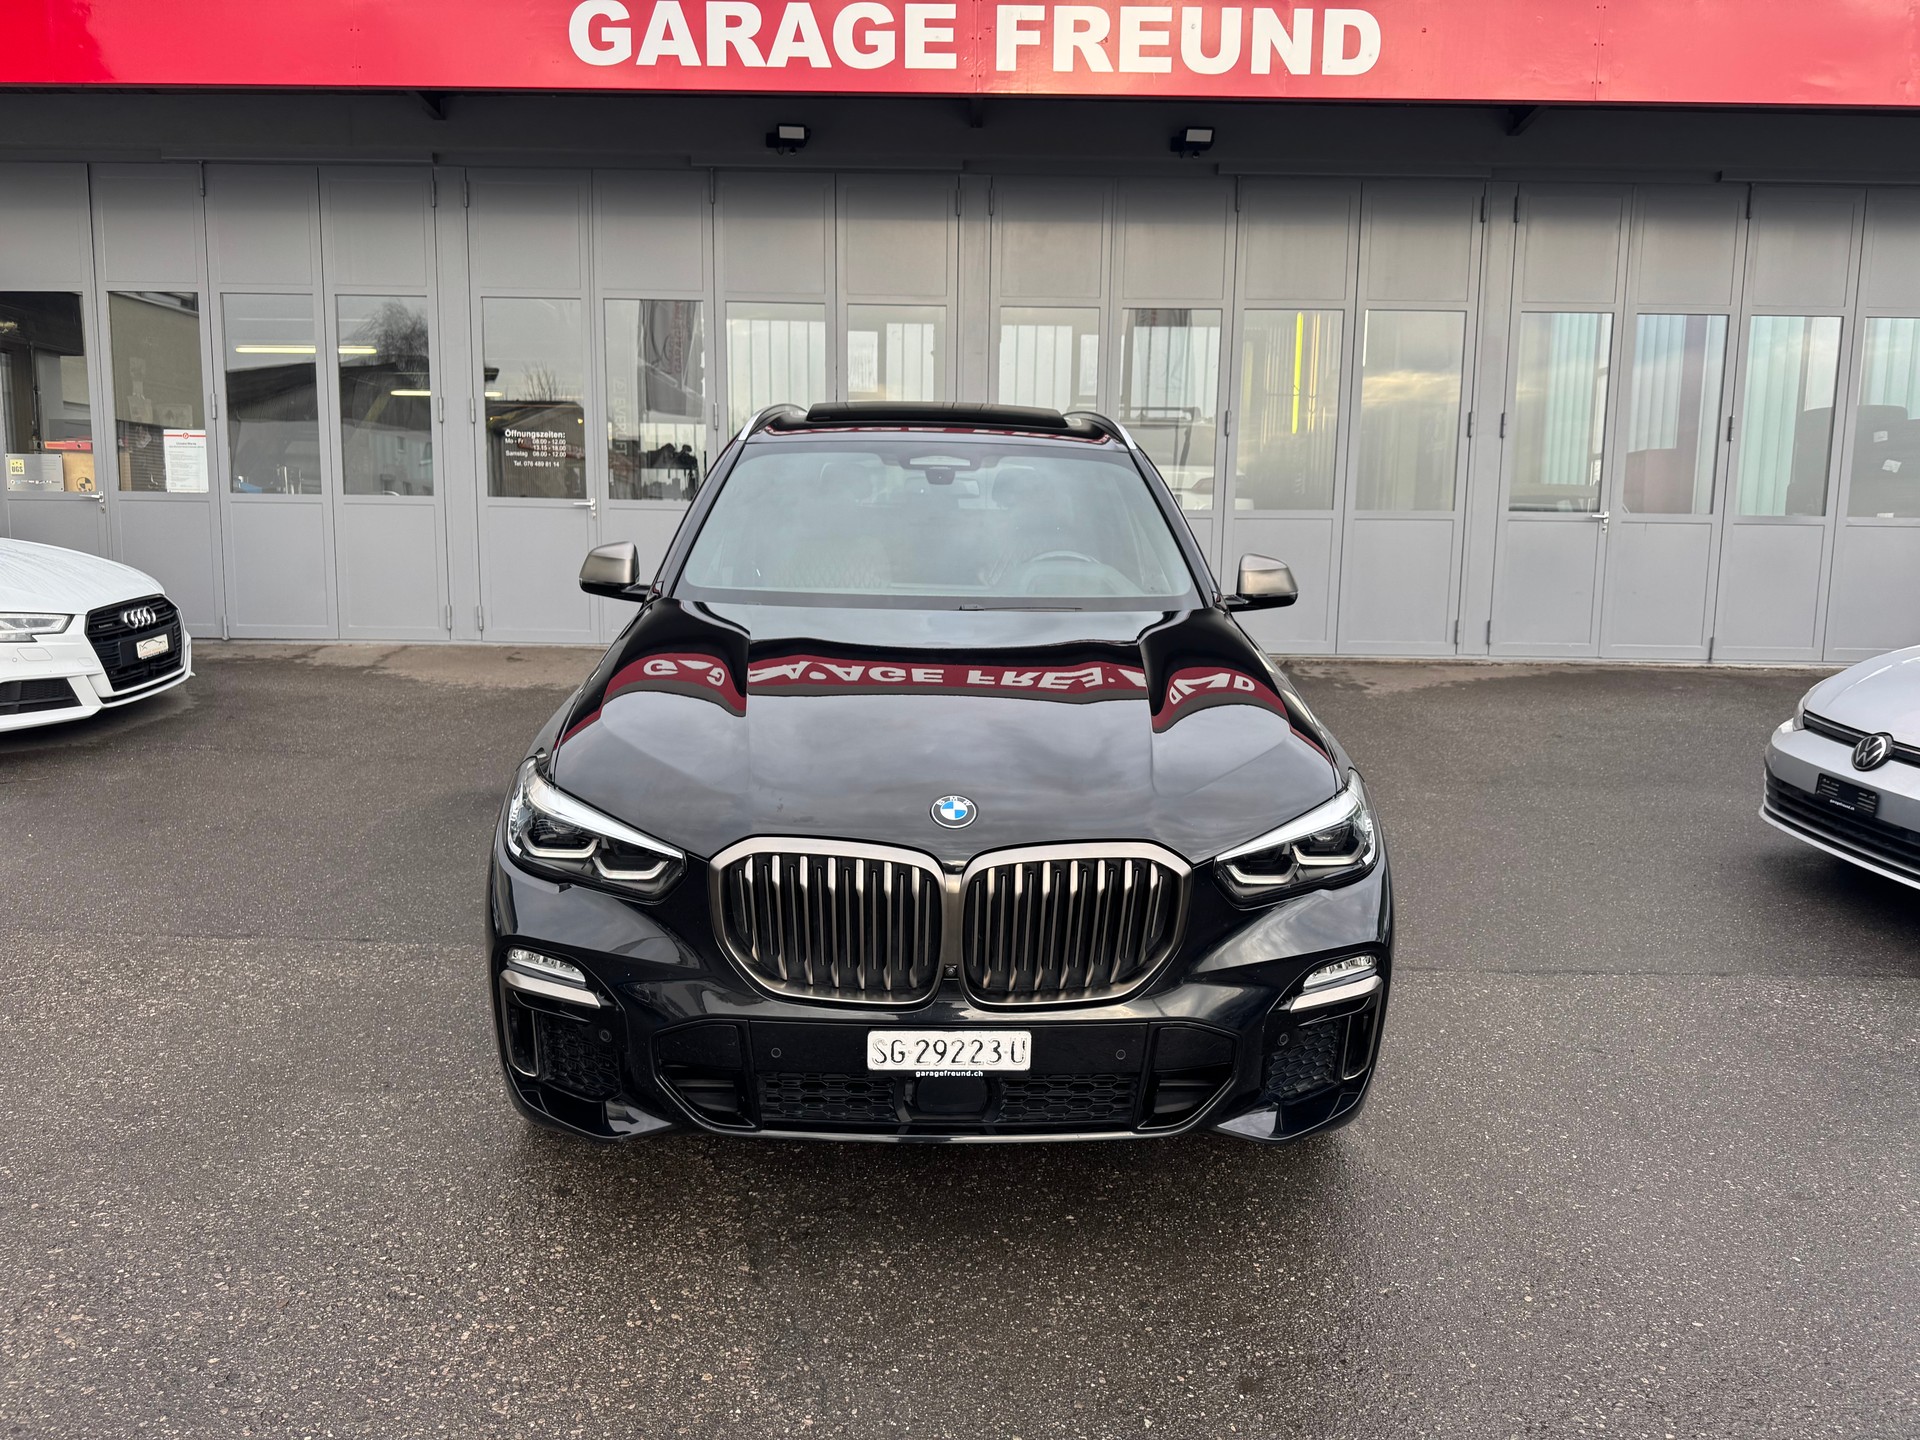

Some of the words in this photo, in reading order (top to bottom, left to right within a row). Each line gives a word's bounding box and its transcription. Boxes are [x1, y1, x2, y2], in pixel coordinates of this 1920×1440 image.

[568, 0, 957, 69] GARAGE
[996, 5, 1381, 76] FREUND
[504, 428, 566, 439] Öffnungszeiten:
[505, 450, 528, 458] Samstag
[915, 1070, 984, 1078] garagefreund.ch
